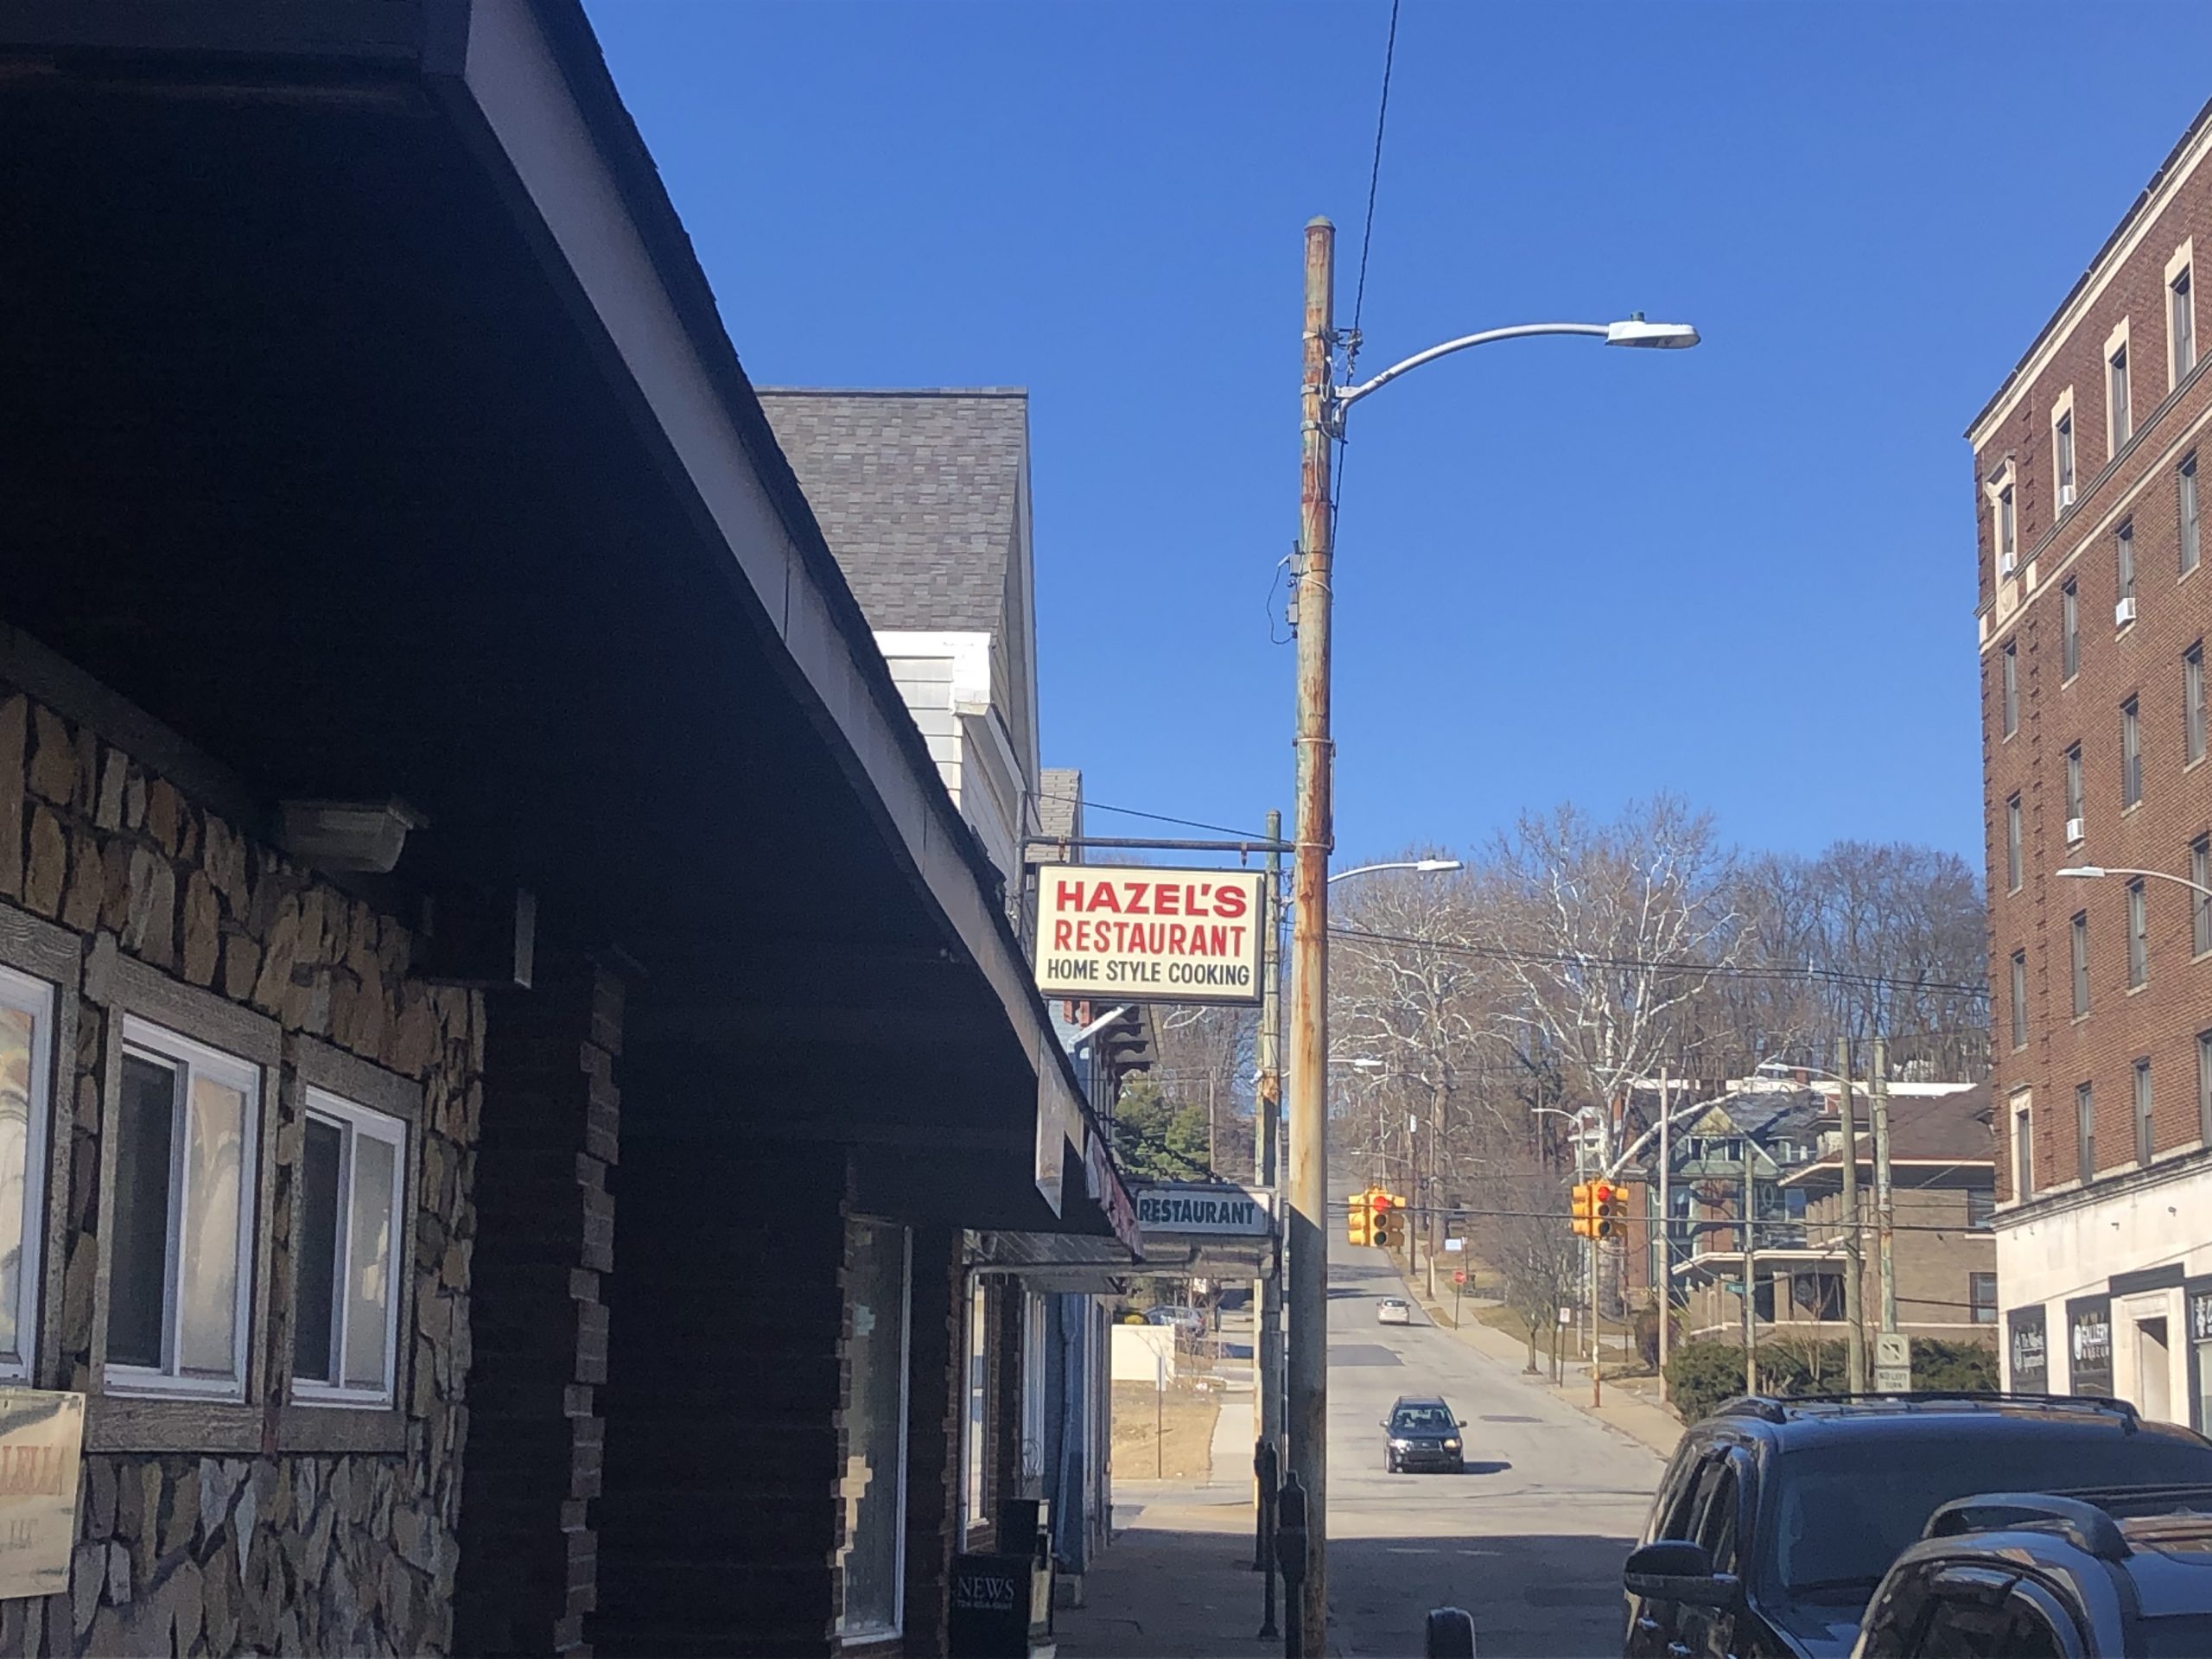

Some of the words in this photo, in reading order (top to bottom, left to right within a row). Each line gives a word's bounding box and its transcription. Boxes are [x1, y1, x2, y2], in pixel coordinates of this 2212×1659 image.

[1056, 880, 1247, 918] HAZEL'S
[1053, 918, 1246, 957] RESTAURANT
[1047, 958, 1099, 981] HOME
[1106, 960, 1161, 982] STYLE
[1168, 962, 1249, 987] COOKING
[1139, 1198, 1255, 1225] RESTAURANT
[1878, 1371, 1890, 1380] NO
[957, 1576, 1014, 1599] NEWS
